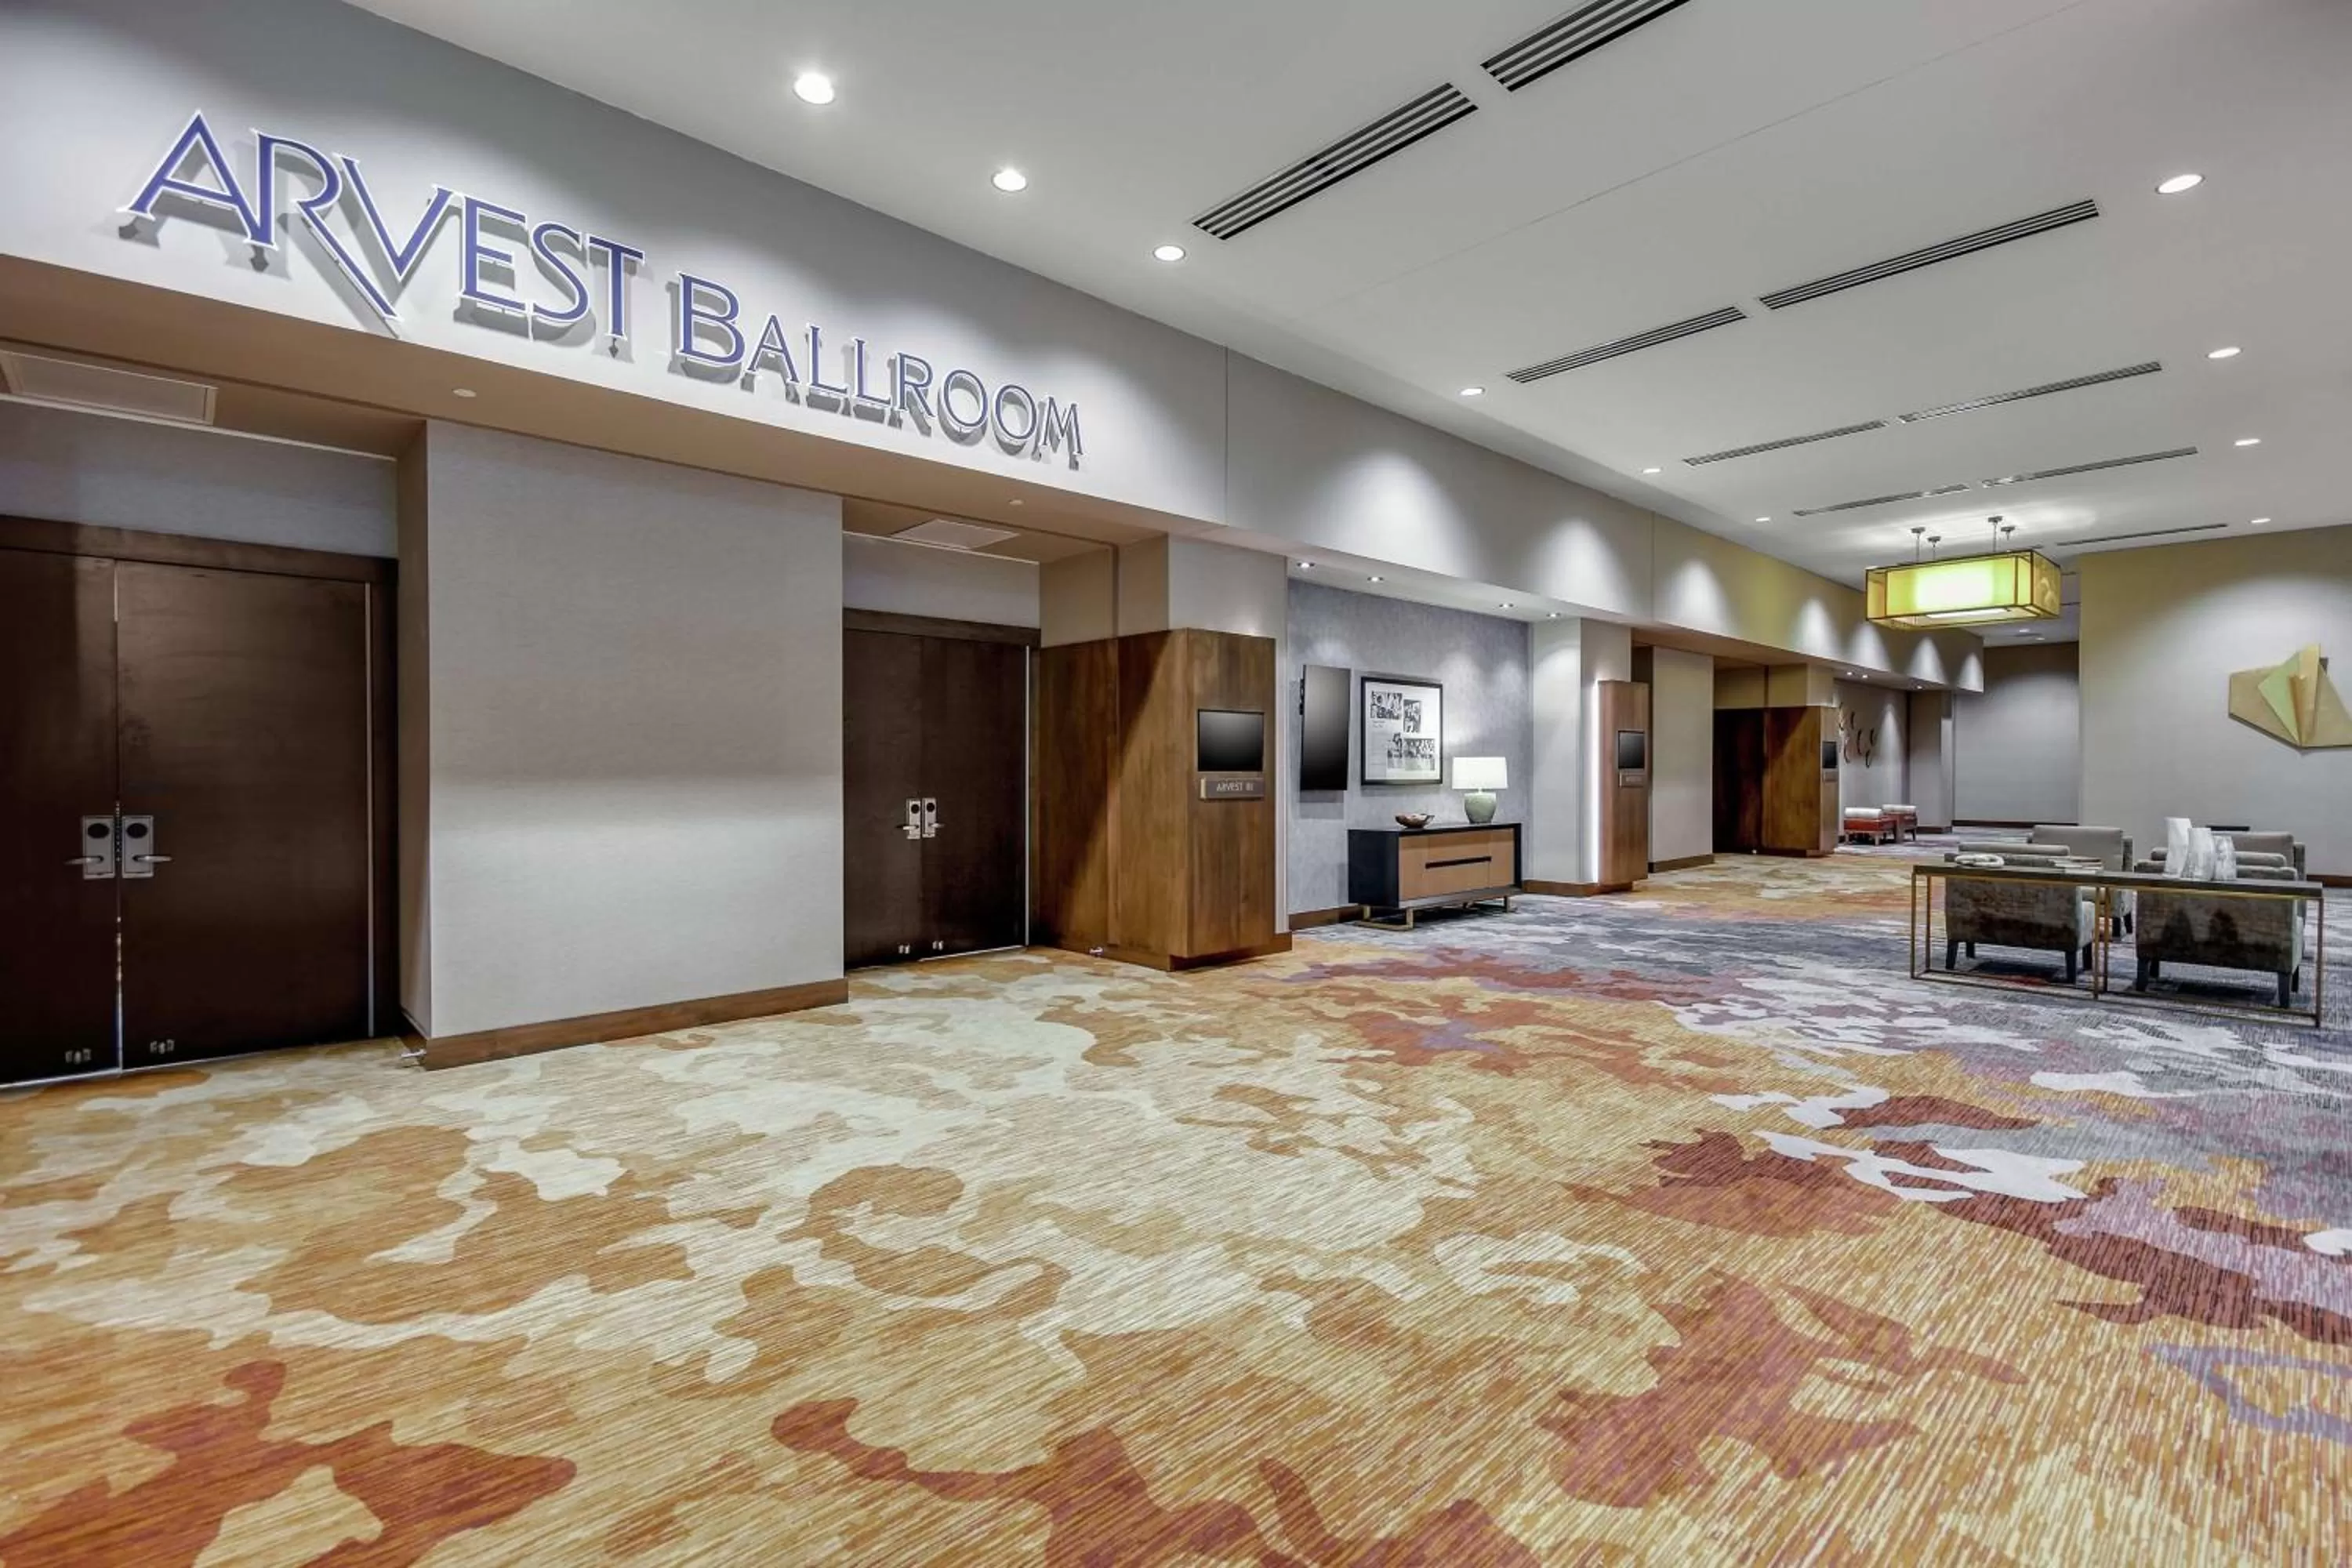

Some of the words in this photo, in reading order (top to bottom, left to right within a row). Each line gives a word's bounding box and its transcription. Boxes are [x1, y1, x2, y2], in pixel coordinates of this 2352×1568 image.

[117, 109, 645, 339] ARVEST
[676, 271, 1086, 456] BALLROOM
[1216, 782, 1243, 791] ARVEST
